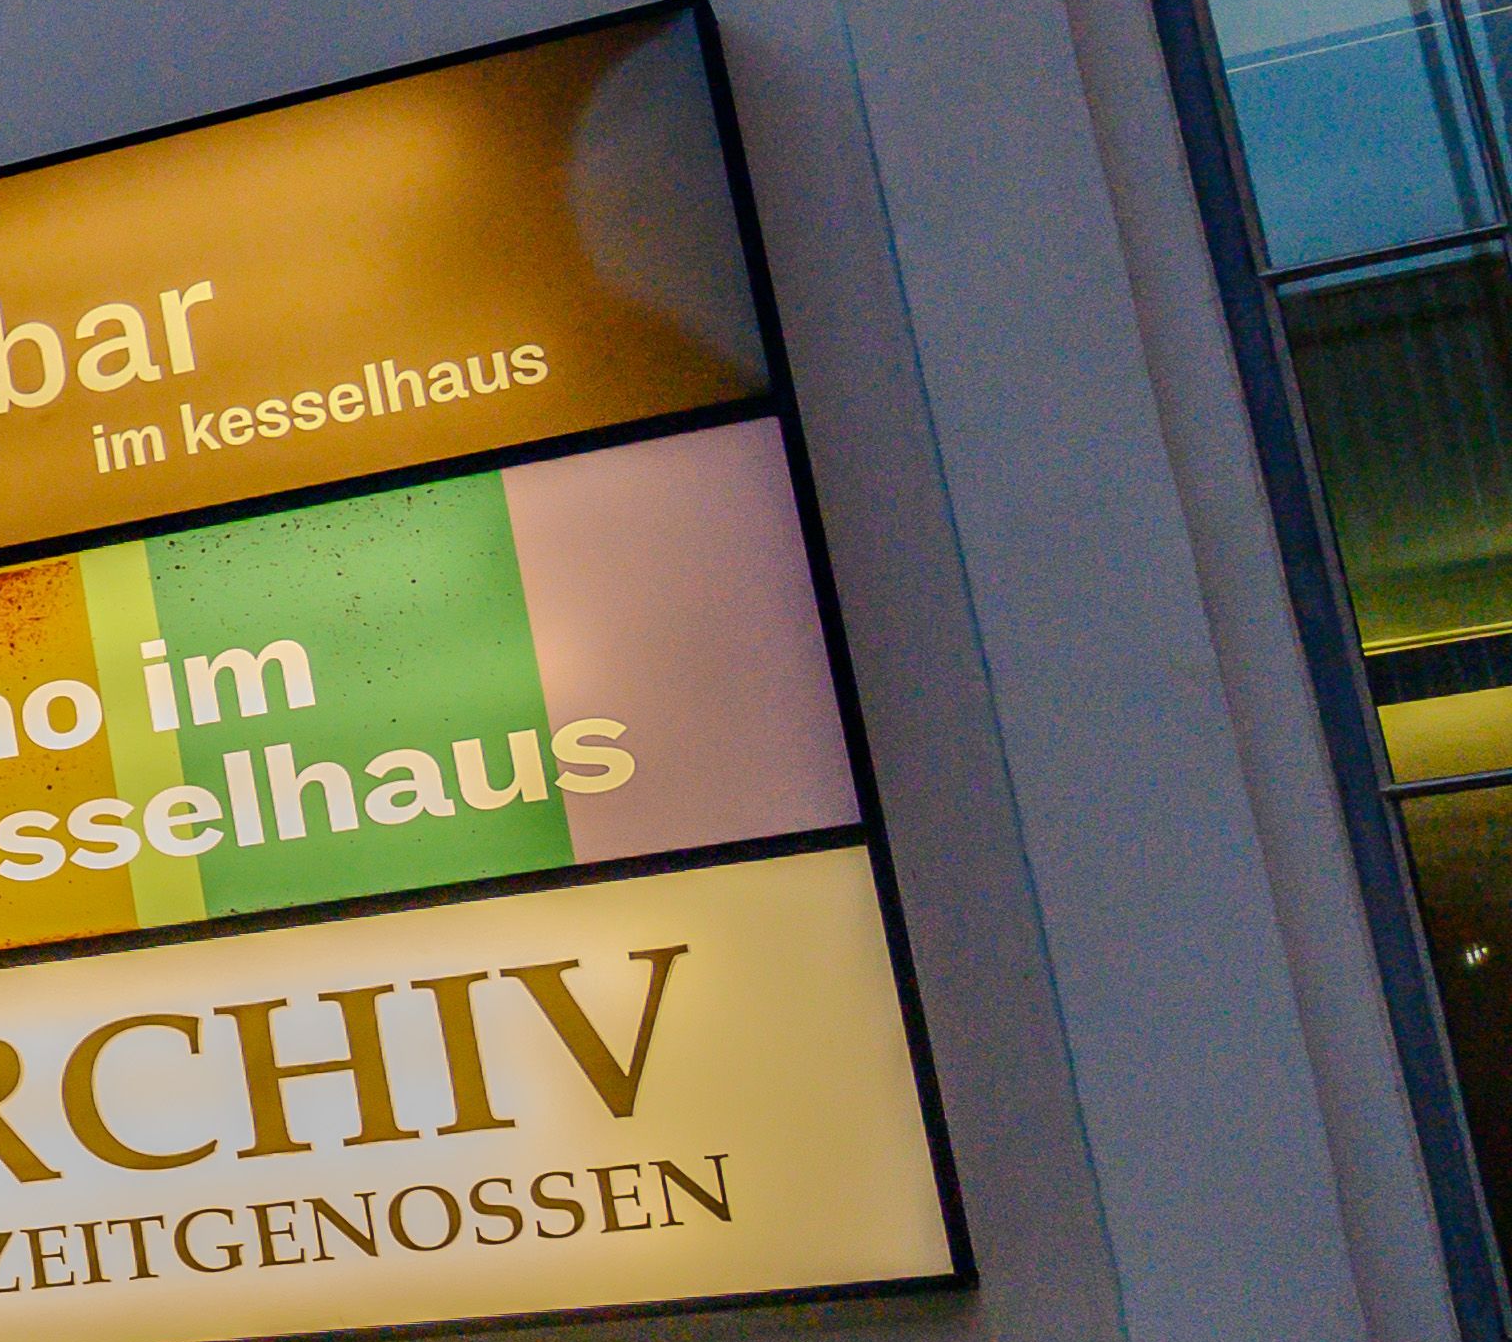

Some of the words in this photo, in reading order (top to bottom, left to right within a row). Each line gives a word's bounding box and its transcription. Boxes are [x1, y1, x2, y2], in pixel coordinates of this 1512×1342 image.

[92, 424, 165, 474] im
[180, 342, 549, 455] kesselhaus
[141, 638, 316, 732] im
